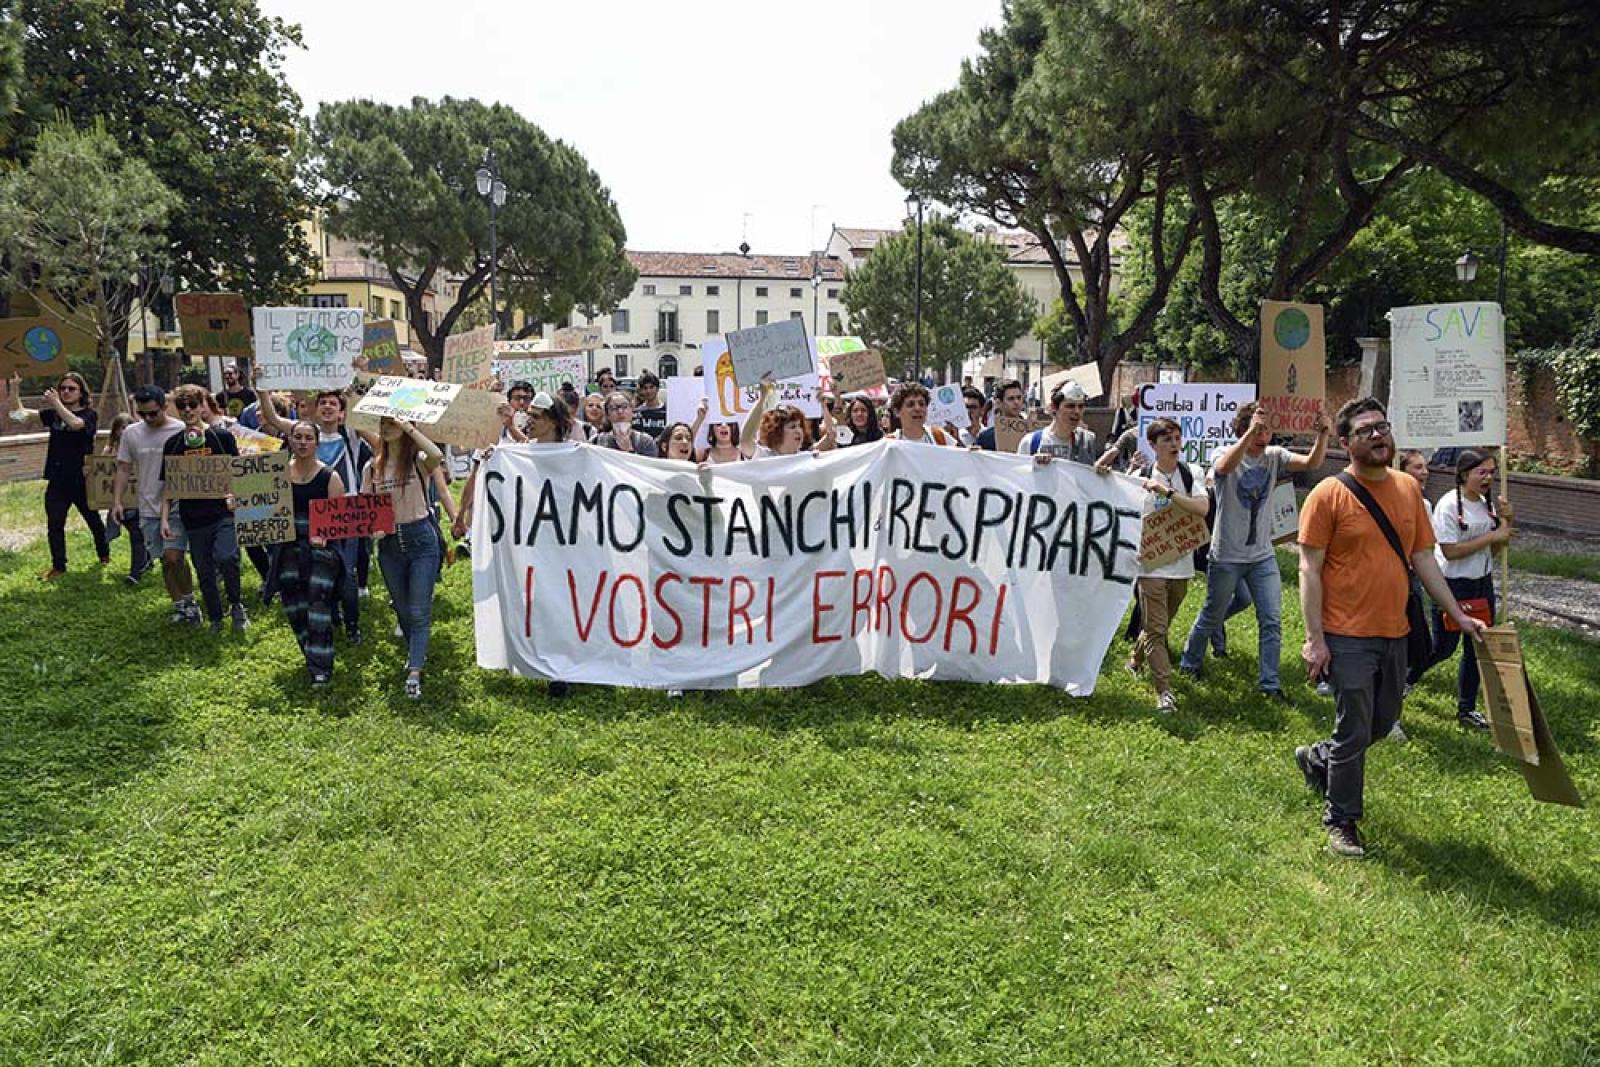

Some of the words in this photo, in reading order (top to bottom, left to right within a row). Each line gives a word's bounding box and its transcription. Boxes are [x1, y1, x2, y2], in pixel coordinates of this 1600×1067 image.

[264, 312, 281, 330] IL
[296, 311, 361, 333] FUTURO
[297, 335, 361, 353] NOSTRO
[447, 329, 489, 355] MORE
[447, 347, 488, 371] TREES
[511, 358, 555, 375] SERVE
[1140, 385, 1193, 412] Cambia
[1200, 392, 1208, 412] il
[231, 454, 270, 477] SAVE
[251, 491, 279, 506] ONLY
[314, 499, 338, 514] UN
[345, 494, 392, 509] ALTRO
[236, 518, 289, 534] ALBERTO
[331, 511, 377, 523] MONDO
[317, 526, 348, 537] NON
[485, 471, 645, 552] SIAMO
[662, 480, 870, 558] STANCHI
[888, 478, 1141, 584] RESPIRARE
[238, 531, 286, 545] ANGELA
[525, 566, 533, 637] I
[567, 570, 774, 649] VOSTRI
[812, 566, 1007, 656] ERRORI
